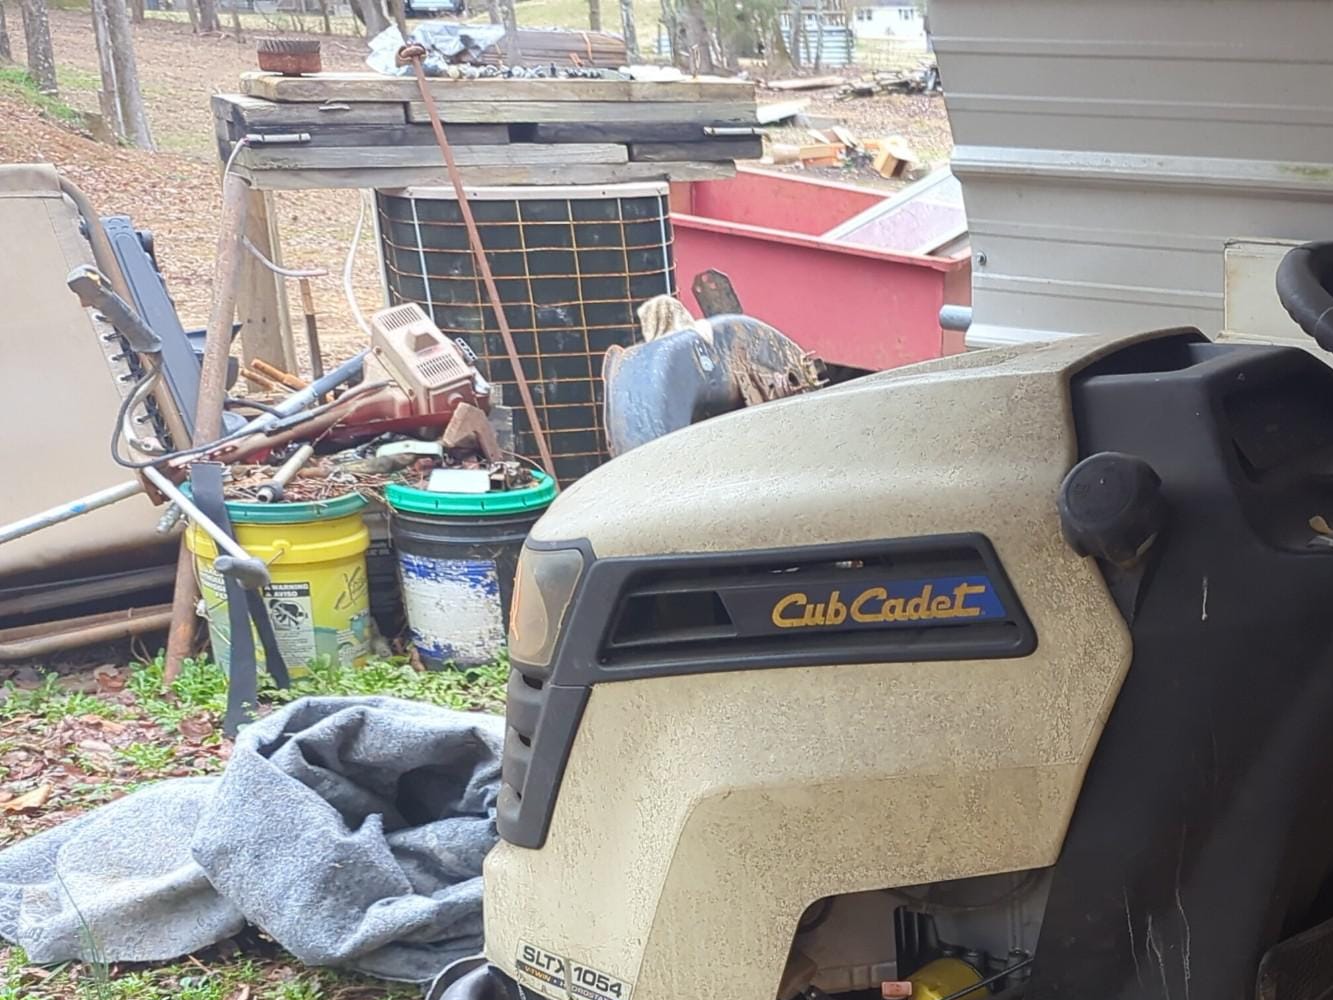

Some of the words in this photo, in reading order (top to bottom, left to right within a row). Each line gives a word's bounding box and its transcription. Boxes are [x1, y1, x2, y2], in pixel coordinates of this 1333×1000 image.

[772, 591, 847, 628] Cub
[850, 584, 986, 623] Cadet
[574, 966, 623, 999] 1054
